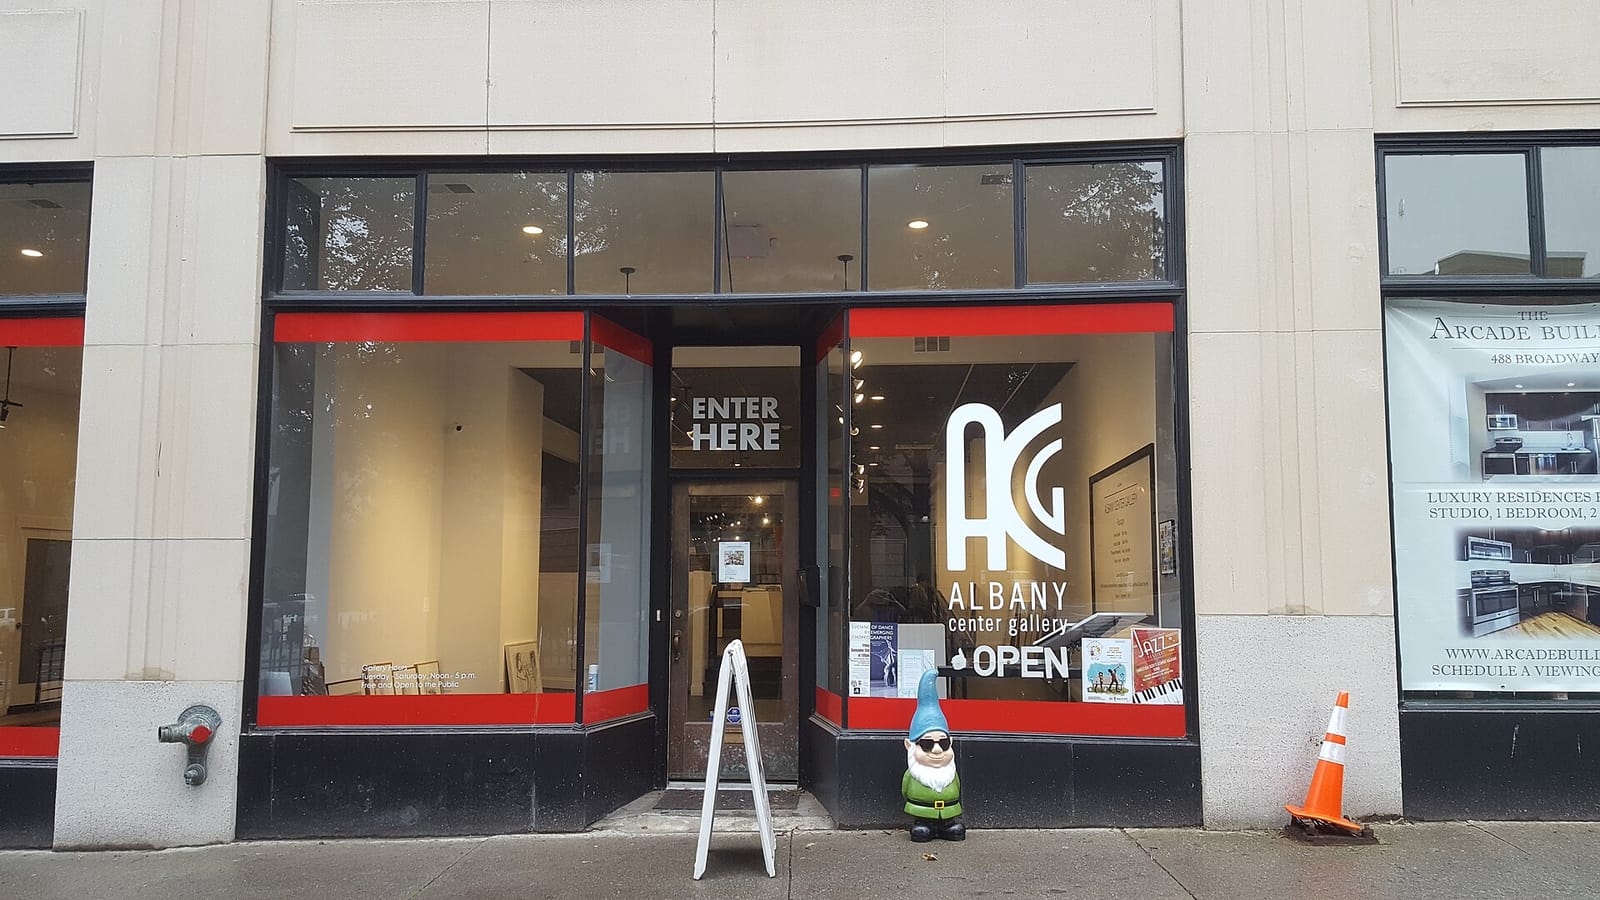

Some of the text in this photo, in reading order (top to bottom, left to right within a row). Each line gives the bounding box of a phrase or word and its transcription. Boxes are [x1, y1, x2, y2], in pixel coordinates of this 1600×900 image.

[1517, 311, 1549, 321] THE
[1540, 325, 1600, 340] BUIL
[1490, 353, 1600, 364] 488 BROADWAY
[692, 397, 780, 419] ENTER
[692, 423, 780, 451] HERE
[1428, 492, 1493, 503] LUXURY
[1497, 491, 1592, 503] RESIDENCES
[1429, 507, 1597, 520] STUDIO, 1 BEDROOM, 2
[948, 581, 1067, 611] ALBANY
[948, 614, 1068, 637] center gallery
[1133, 629, 1181, 658] JAZZ
[973, 645, 1070, 679] OPEN
[361, 673, 389, 681] Tuesday
[1431, 664, 1600, 677] SCHEDULE A VIEWING
[361, 681, 377, 689] Free
[377, 681, 392, 689] and
[393, 681, 415, 690] Open
[437, 680, 460, 688] Public
